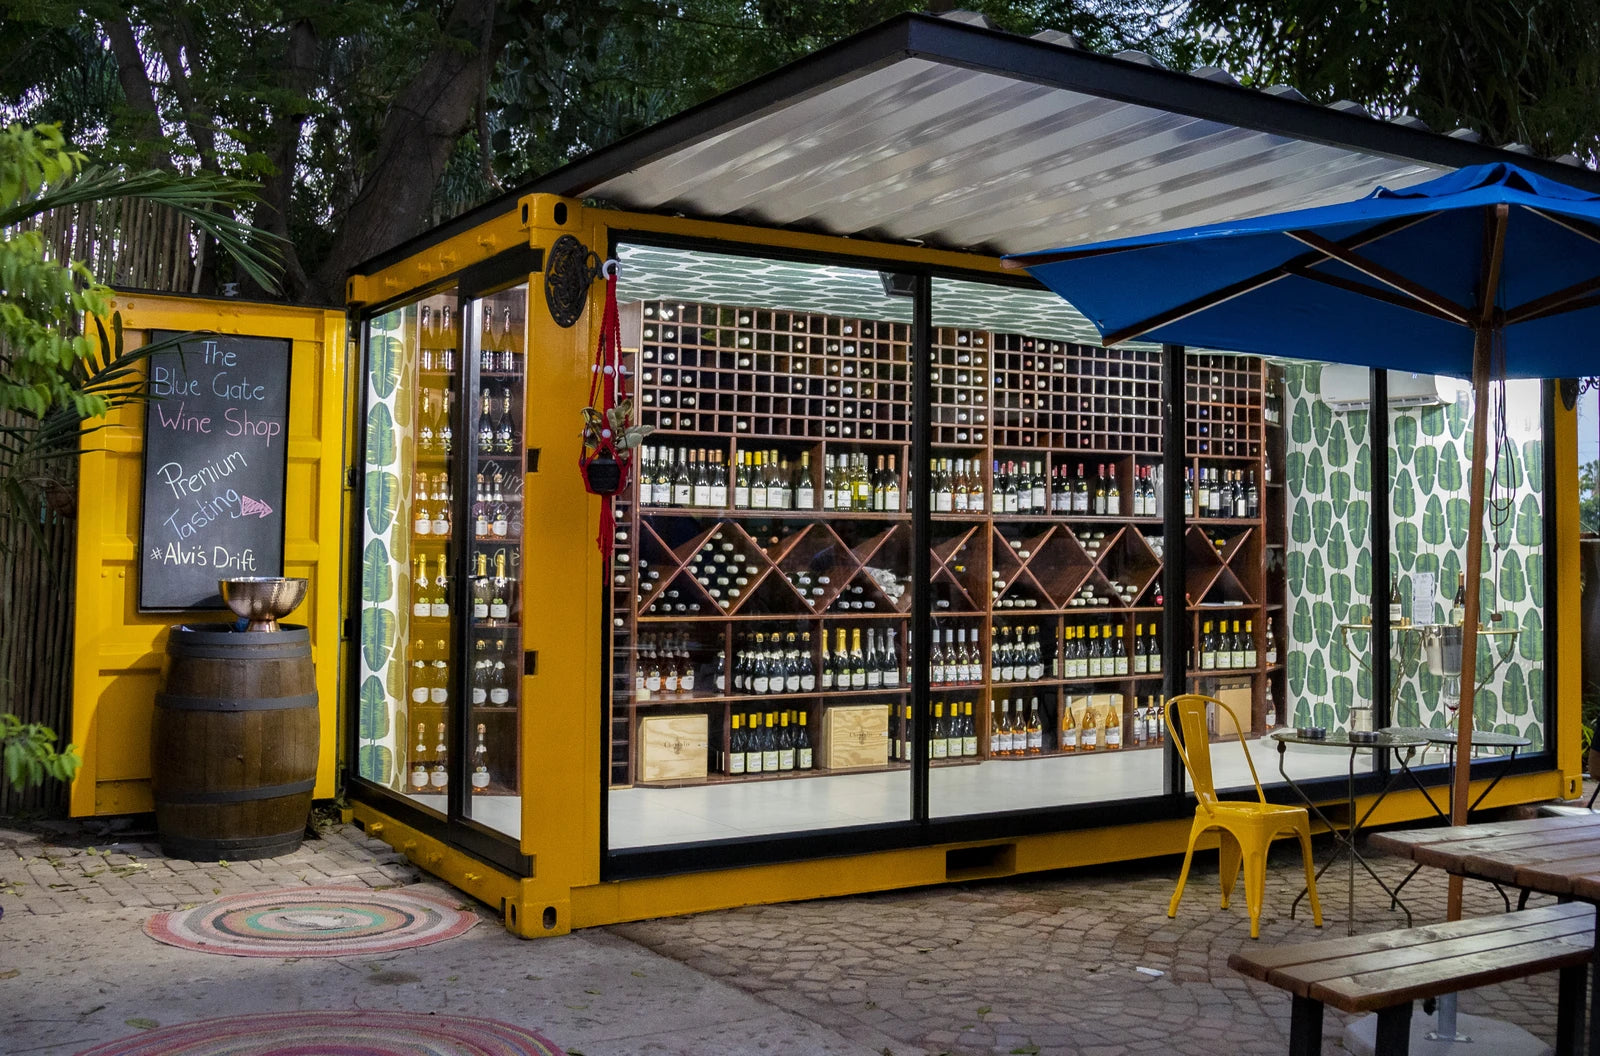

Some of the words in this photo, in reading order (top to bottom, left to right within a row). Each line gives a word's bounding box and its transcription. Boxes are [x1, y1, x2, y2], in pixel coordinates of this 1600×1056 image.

[202, 340, 237, 367] The
[155, 366, 201, 396] Blue
[212, 371, 265, 400] Gate
[157, 401, 212, 434] Wine
[224, 407, 281, 448] Shop
[157, 451, 248, 499] Premium
[163, 489, 243, 541] Tasting
[150, 541, 208, 566] #Alvi's
[213, 546, 257, 571] Drift
